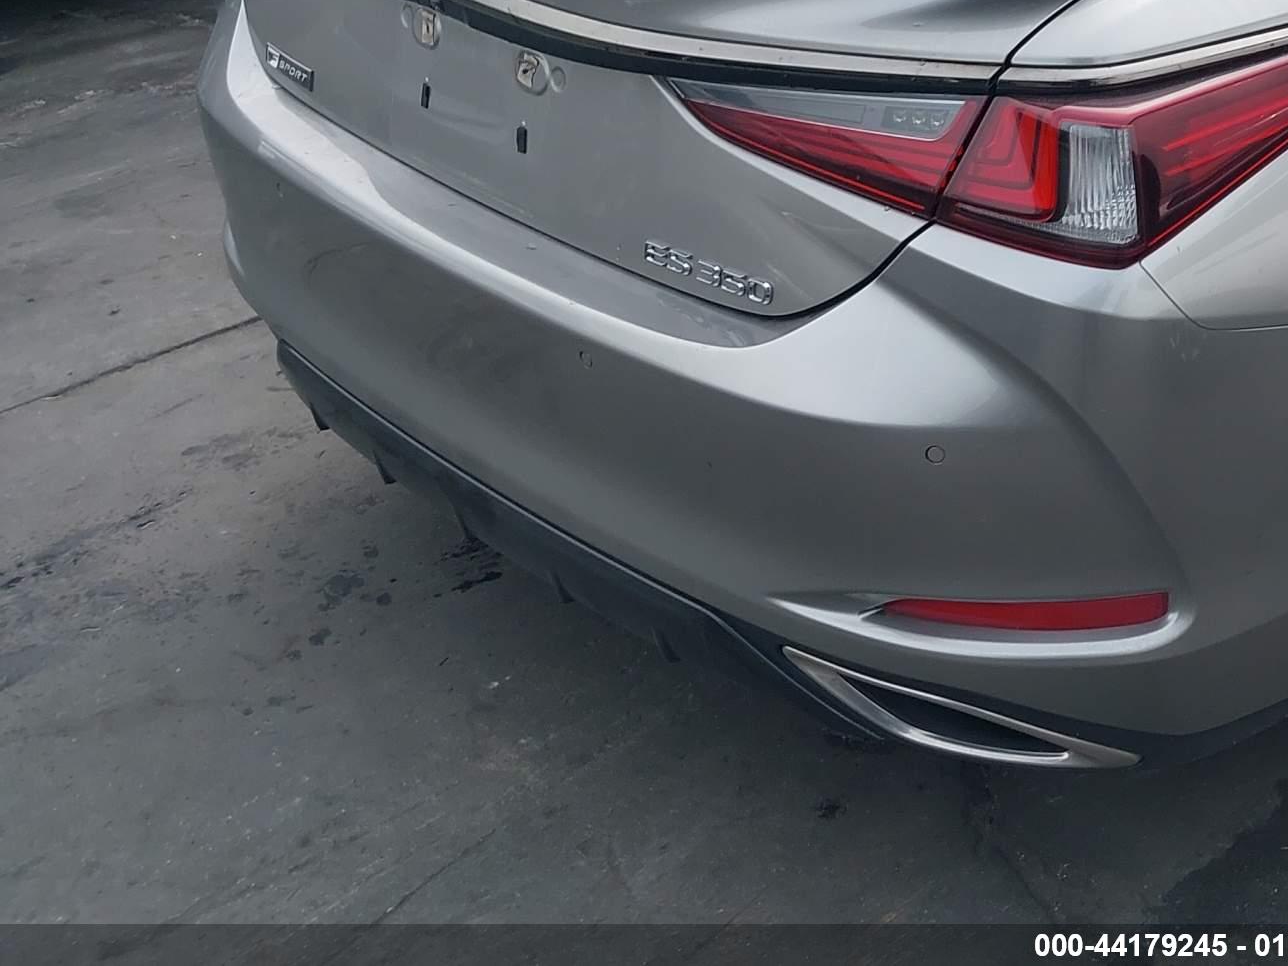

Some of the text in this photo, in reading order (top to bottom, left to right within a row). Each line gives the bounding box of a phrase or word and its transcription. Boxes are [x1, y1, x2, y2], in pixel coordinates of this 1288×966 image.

[279, 60, 308, 82] SPORT
[644, 240, 773, 305] ES 350
